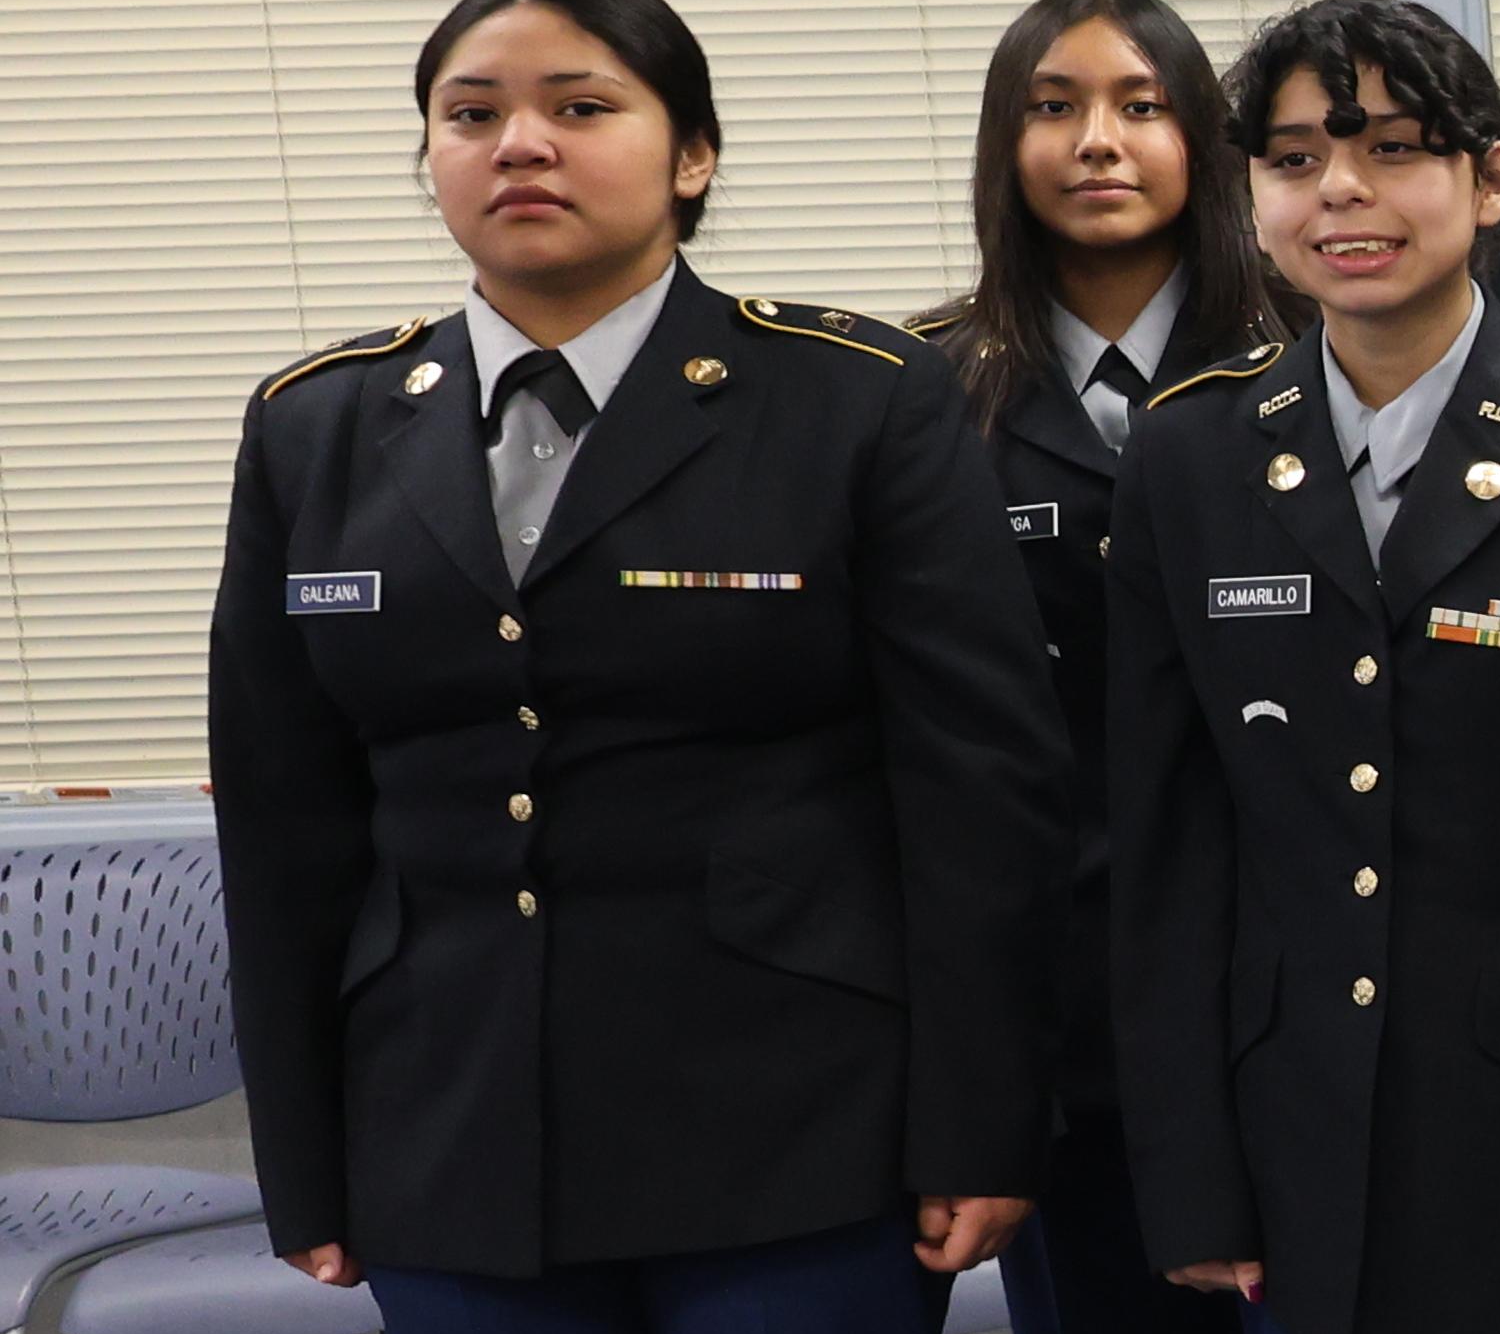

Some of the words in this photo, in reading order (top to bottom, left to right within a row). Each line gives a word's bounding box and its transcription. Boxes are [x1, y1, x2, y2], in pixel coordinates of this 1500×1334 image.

[1010, 515, 1032, 532] GA
[300, 584, 361, 604] GALEANA
[1217, 586, 1297, 607] CAMARILLO
